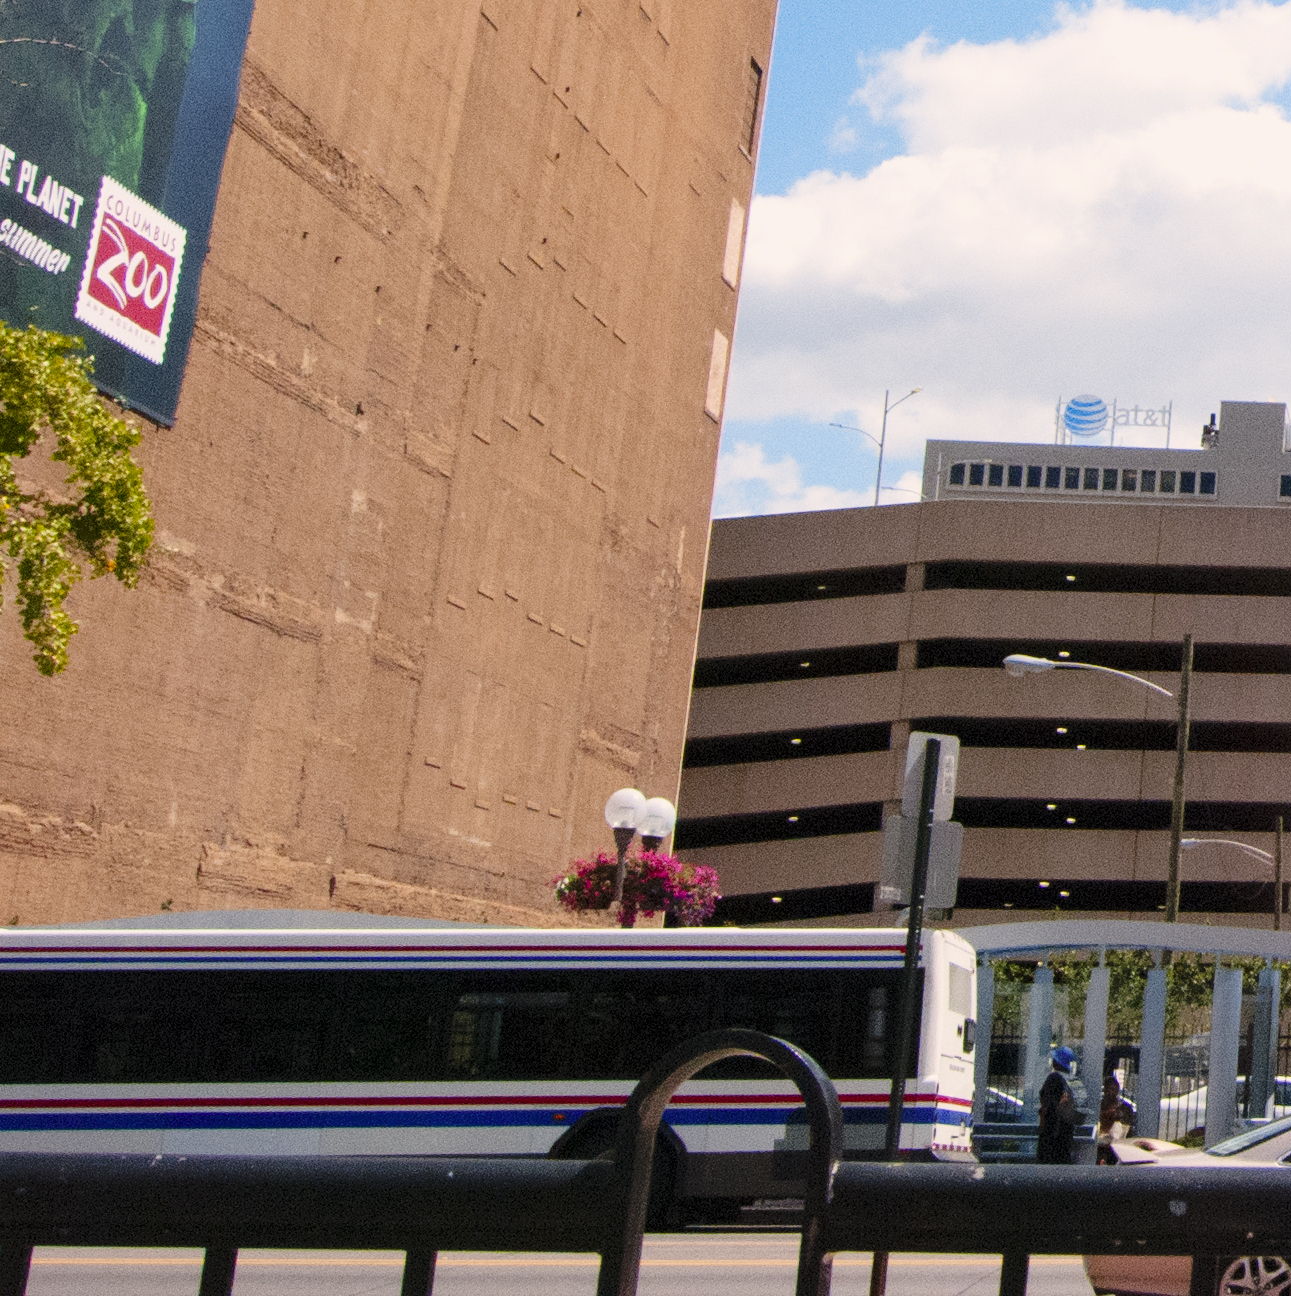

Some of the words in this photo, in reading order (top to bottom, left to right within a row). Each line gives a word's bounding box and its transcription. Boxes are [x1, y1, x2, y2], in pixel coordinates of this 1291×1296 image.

[16, 159, 85, 230] PLANET
[106, 194, 177, 253] COLUMBUS
[0, 217, 72, 276] summer
[86, 300, 105, 317] AND
[109, 313, 157, 347] AQUARIUM
[1115, 404, 1171, 427] at&t
